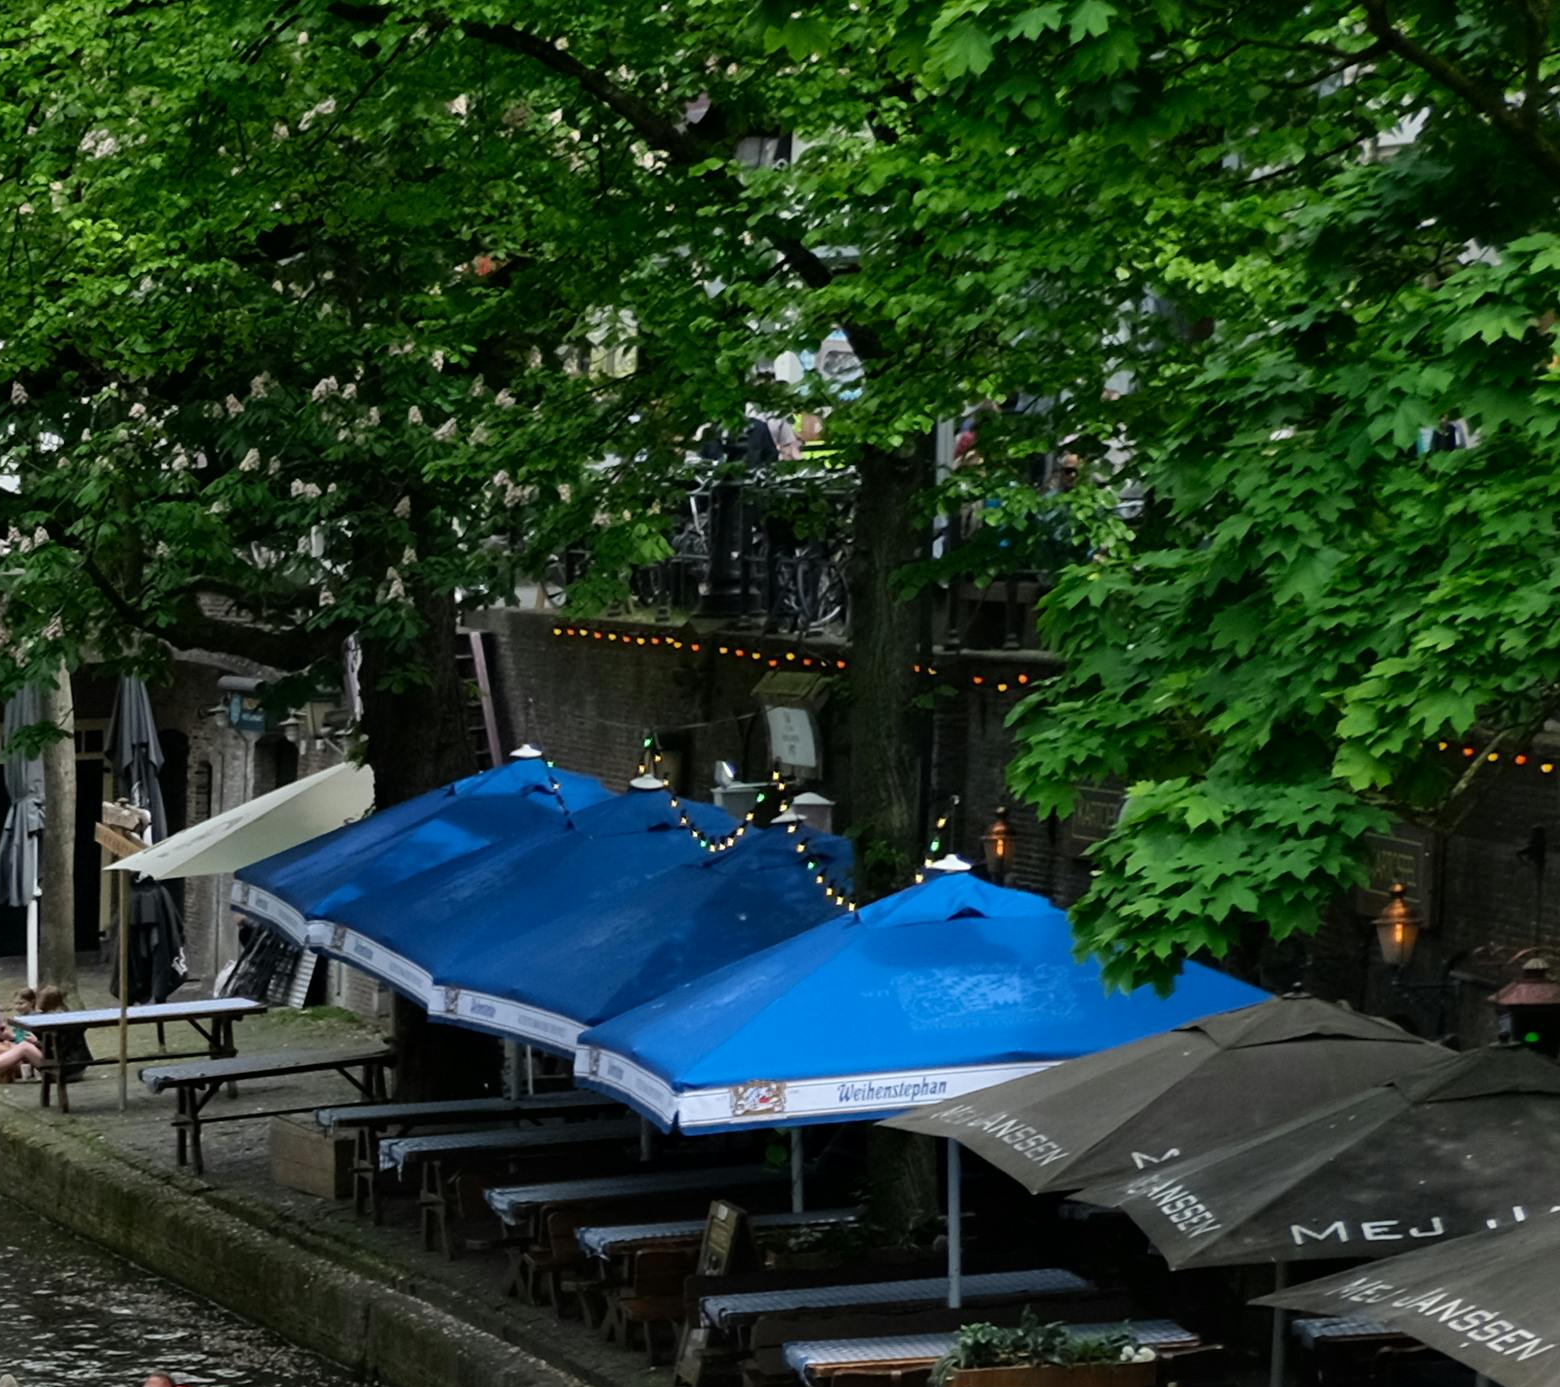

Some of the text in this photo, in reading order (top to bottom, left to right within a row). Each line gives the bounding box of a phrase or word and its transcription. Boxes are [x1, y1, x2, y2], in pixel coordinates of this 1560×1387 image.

[837, 1080, 947, 1103] Weihenstephan
[1290, 1216, 1444, 1246] MEJ
[1392, 1287, 1556, 1361] JANSSEN
